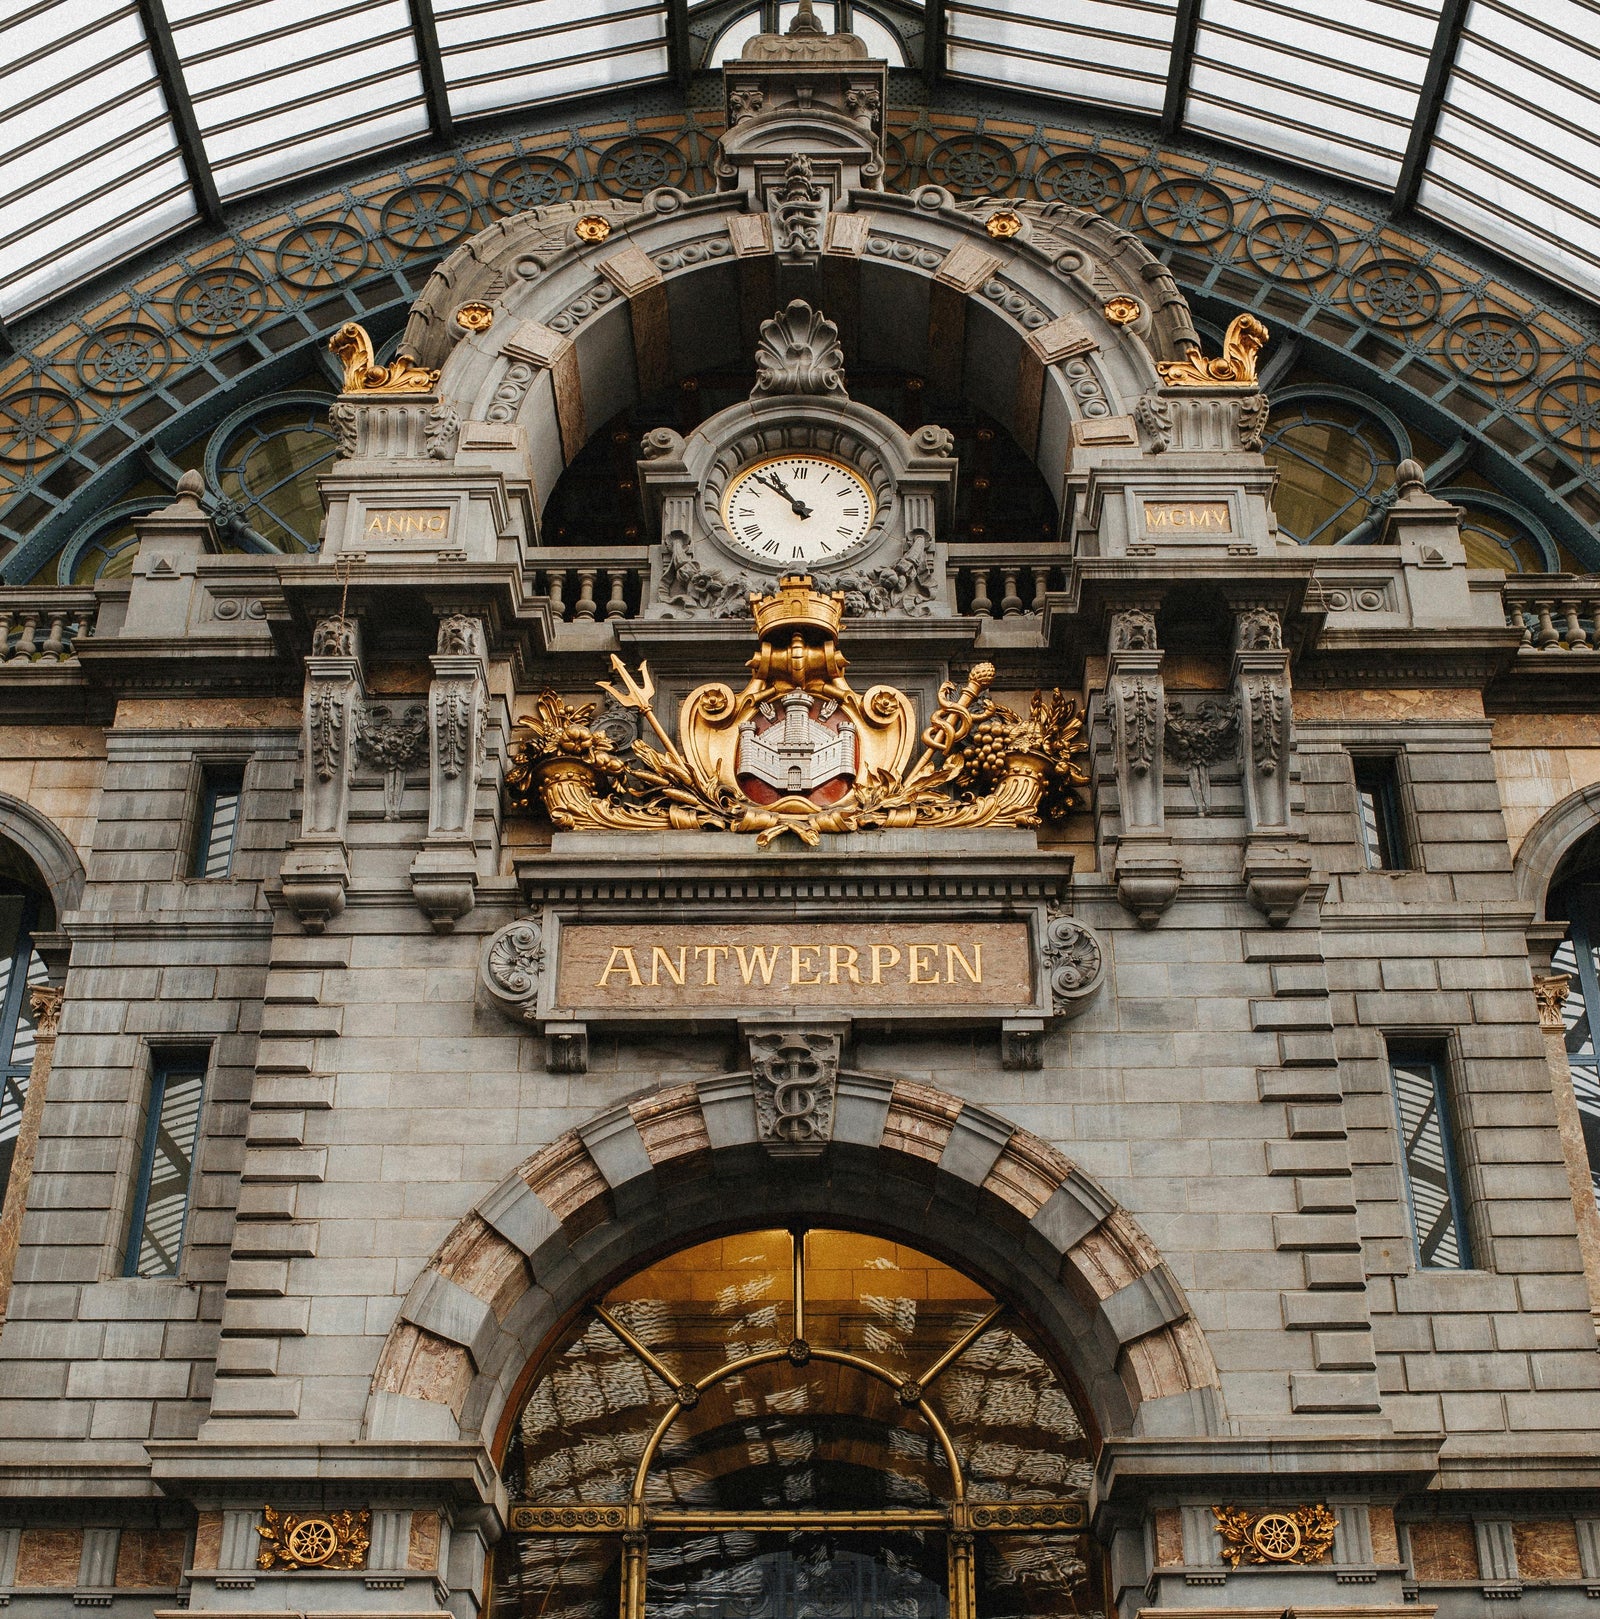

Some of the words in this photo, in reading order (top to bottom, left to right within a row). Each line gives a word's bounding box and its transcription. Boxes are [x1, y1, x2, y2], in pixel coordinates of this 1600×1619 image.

[792, 467, 808, 480] XII
[746, 487, 762, 498] X
[837, 487, 852, 498] II
[739, 508, 755, 517] IX
[843, 508, 859, 517] III
[1146, 509, 1228, 526] MCMV
[368, 515, 446, 533] ANNO
[743, 524, 763, 541] VIII
[762, 539, 780, 555] VII
[792, 546, 805, 559] VI
[595, 942, 983, 986] ANTWERPEN
